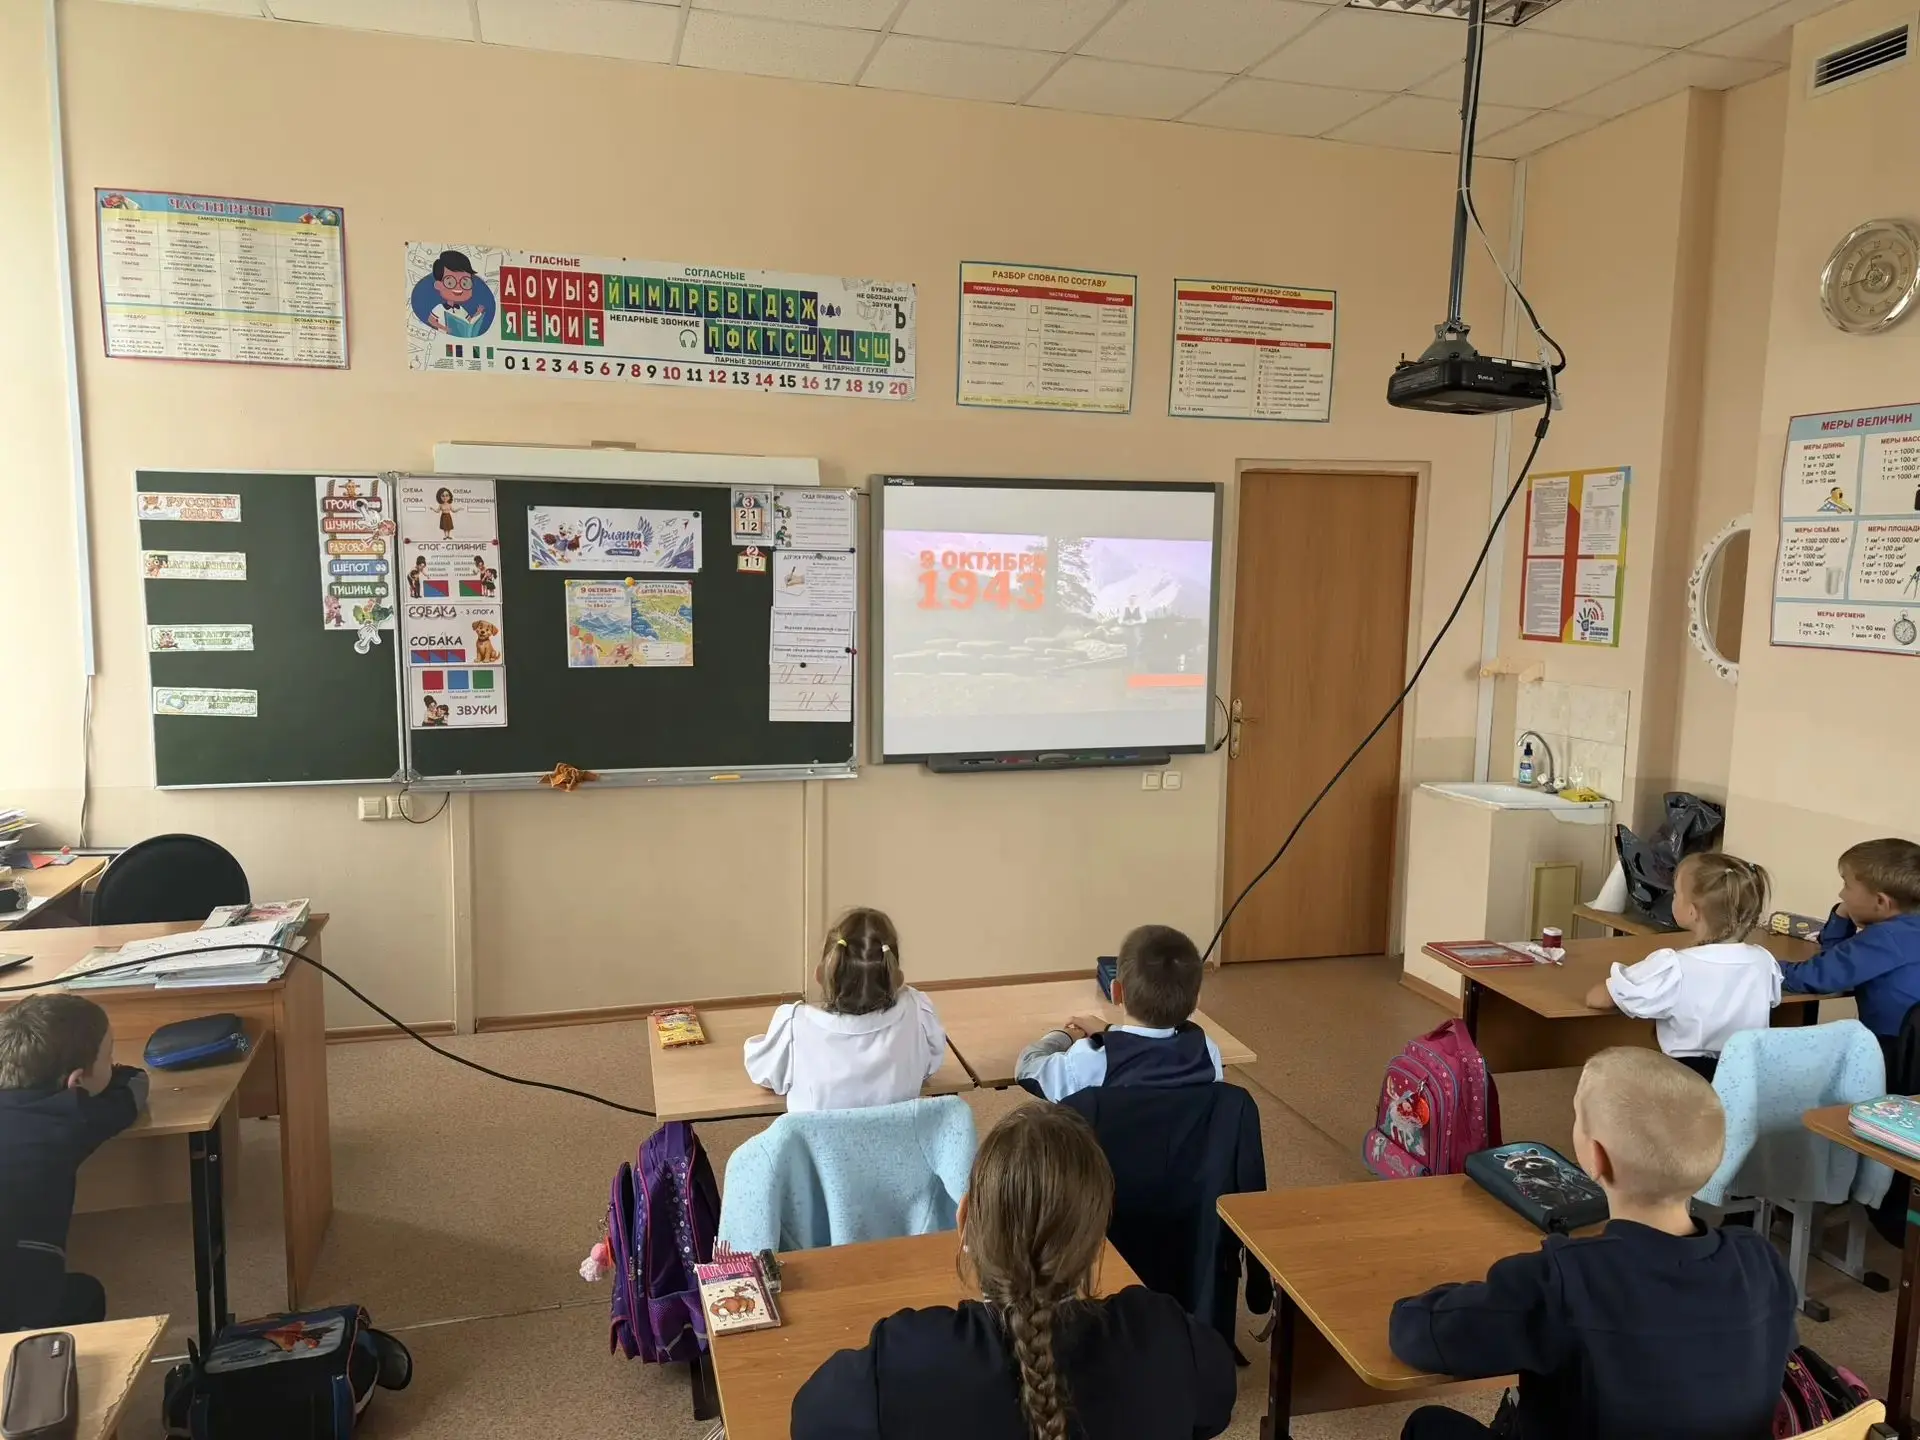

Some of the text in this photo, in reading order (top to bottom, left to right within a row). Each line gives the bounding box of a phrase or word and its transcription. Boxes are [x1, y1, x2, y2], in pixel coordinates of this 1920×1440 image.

[168, 197, 272, 218] ЧАСТИ РЕЧИ
[529, 255, 580, 267] ГЛАСНЫЕ
[685, 268, 745, 280] СОГЛАСНЫЕ
[992, 271, 1107, 287] РАЗБОР СЛОВА ПО СОСТАВУ
[504, 274, 598, 302] А О У Ы Э
[1211, 285, 1259, 294] ФОНЕТИЧЕСКИЙ
[506, 311, 599, 340] Я Ё Ю И Е
[610, 314, 700, 328] НЕПАРНЫЕ ЗВОНКИЕ
[715, 356, 745, 365] ПАРНЫЕ
[823, 364, 888, 374] НЕПАРНЫЕ ГЛУХИЕ
[505, 356, 907, 395] 0 1 2 3 4 5 6 7 8 9 10 11 12 13 14 15 16 17 18 19 20
[1821, 413, 1912, 430] МЕРЫ ВЕЛИЧИН
[744, 497, 752, 506] 3
[740, 510, 746, 518] 2
[751, 523, 758, 531] 2
[919, 550, 1047, 572] 9 ОКТЯБРЯ
[332, 585, 373, 596] ТИШИНА
[917, 570, 1045, 612] 1943
[409, 606, 457, 616] СОБАКА
[410, 636, 463, 646] СОБАКА
[457, 705, 497, 715] ЗВУКИ
